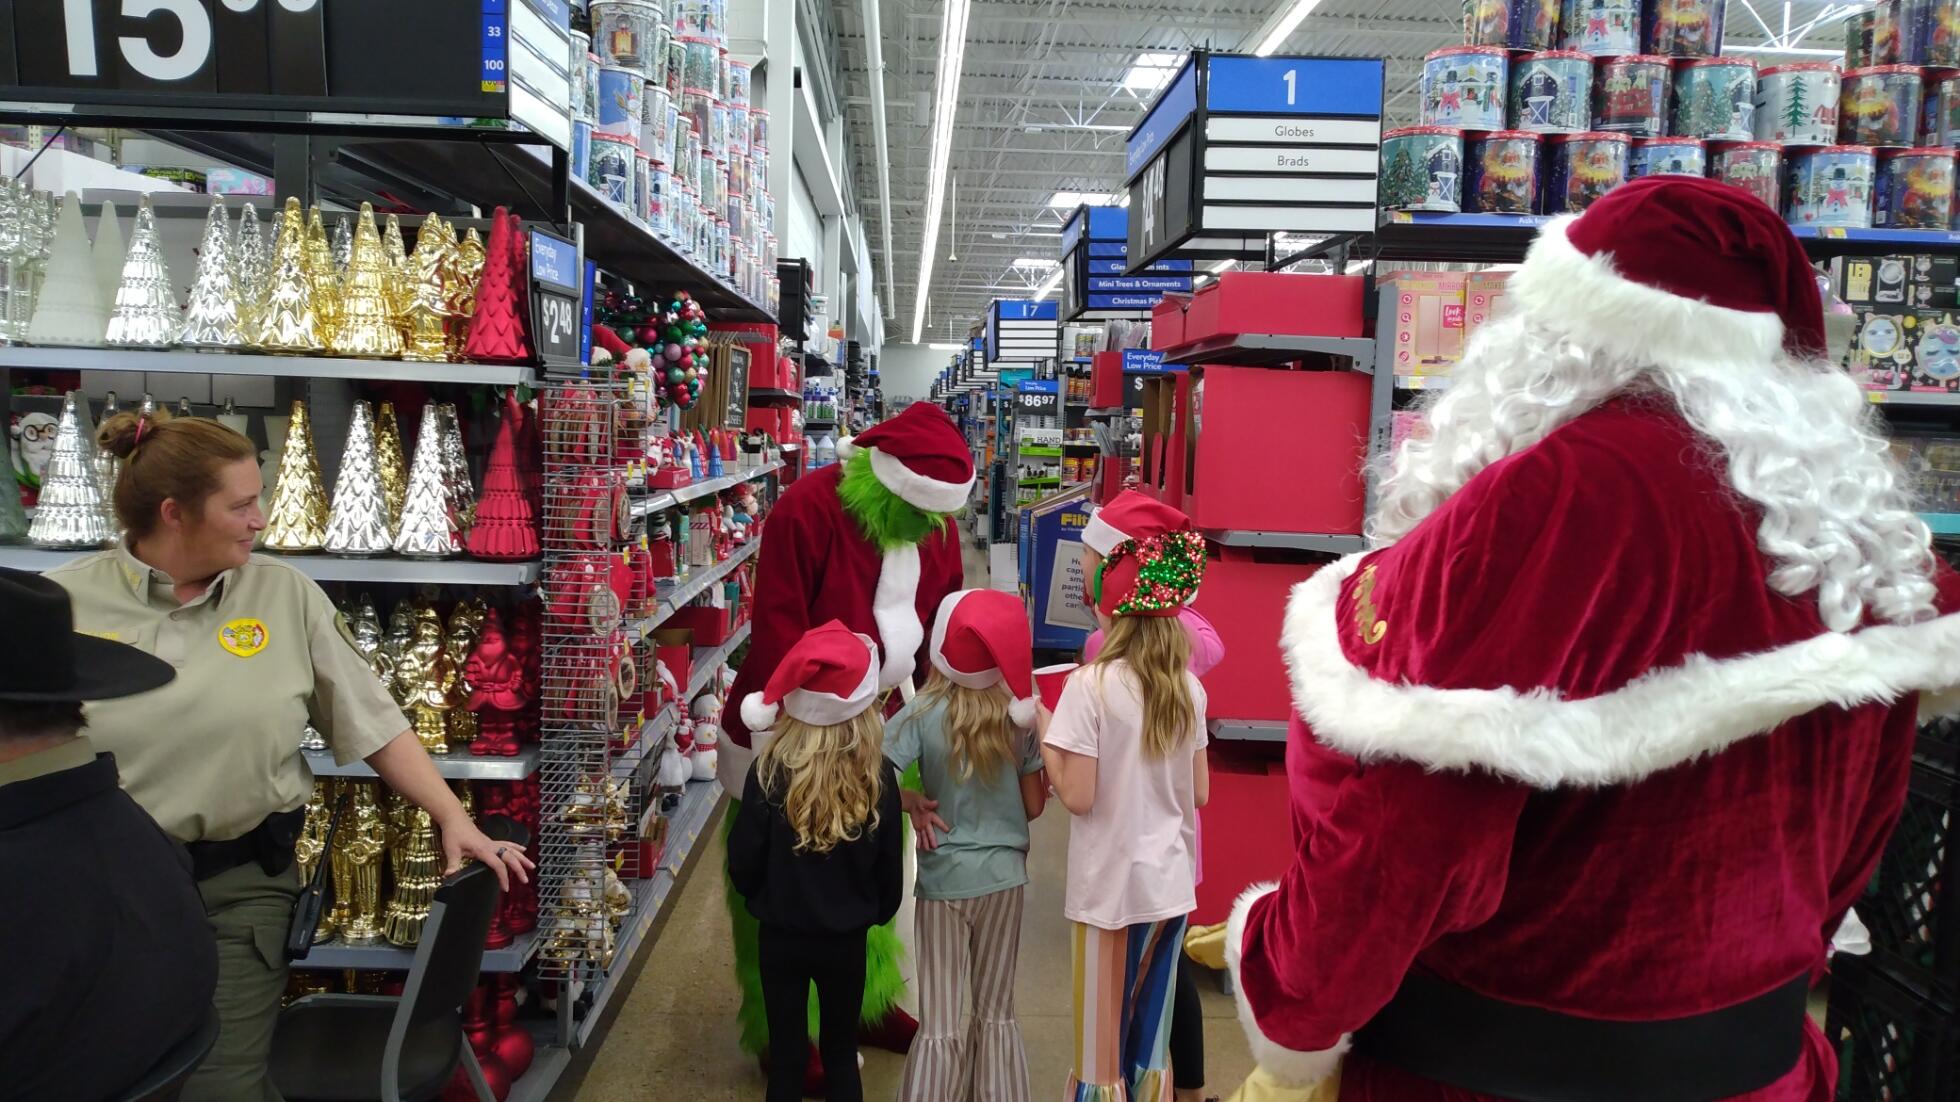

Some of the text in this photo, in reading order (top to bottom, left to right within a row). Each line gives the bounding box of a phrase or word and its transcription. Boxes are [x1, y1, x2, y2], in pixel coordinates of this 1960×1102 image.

[487, 26, 502, 37] 33
[484, 60, 504, 71] 100
[1282, 69, 1297, 105] 1
[1275, 125, 1315, 138] Globes
[1277, 155, 1309, 168] Brads
[1112, 297, 1147, 305] Christmas
[1127, 352, 1160, 363] Everyday
[1143, 362, 1162, 370] Price
[1037, 435, 1062, 444] HAND
[1061, 513, 1087, 526] Filt
